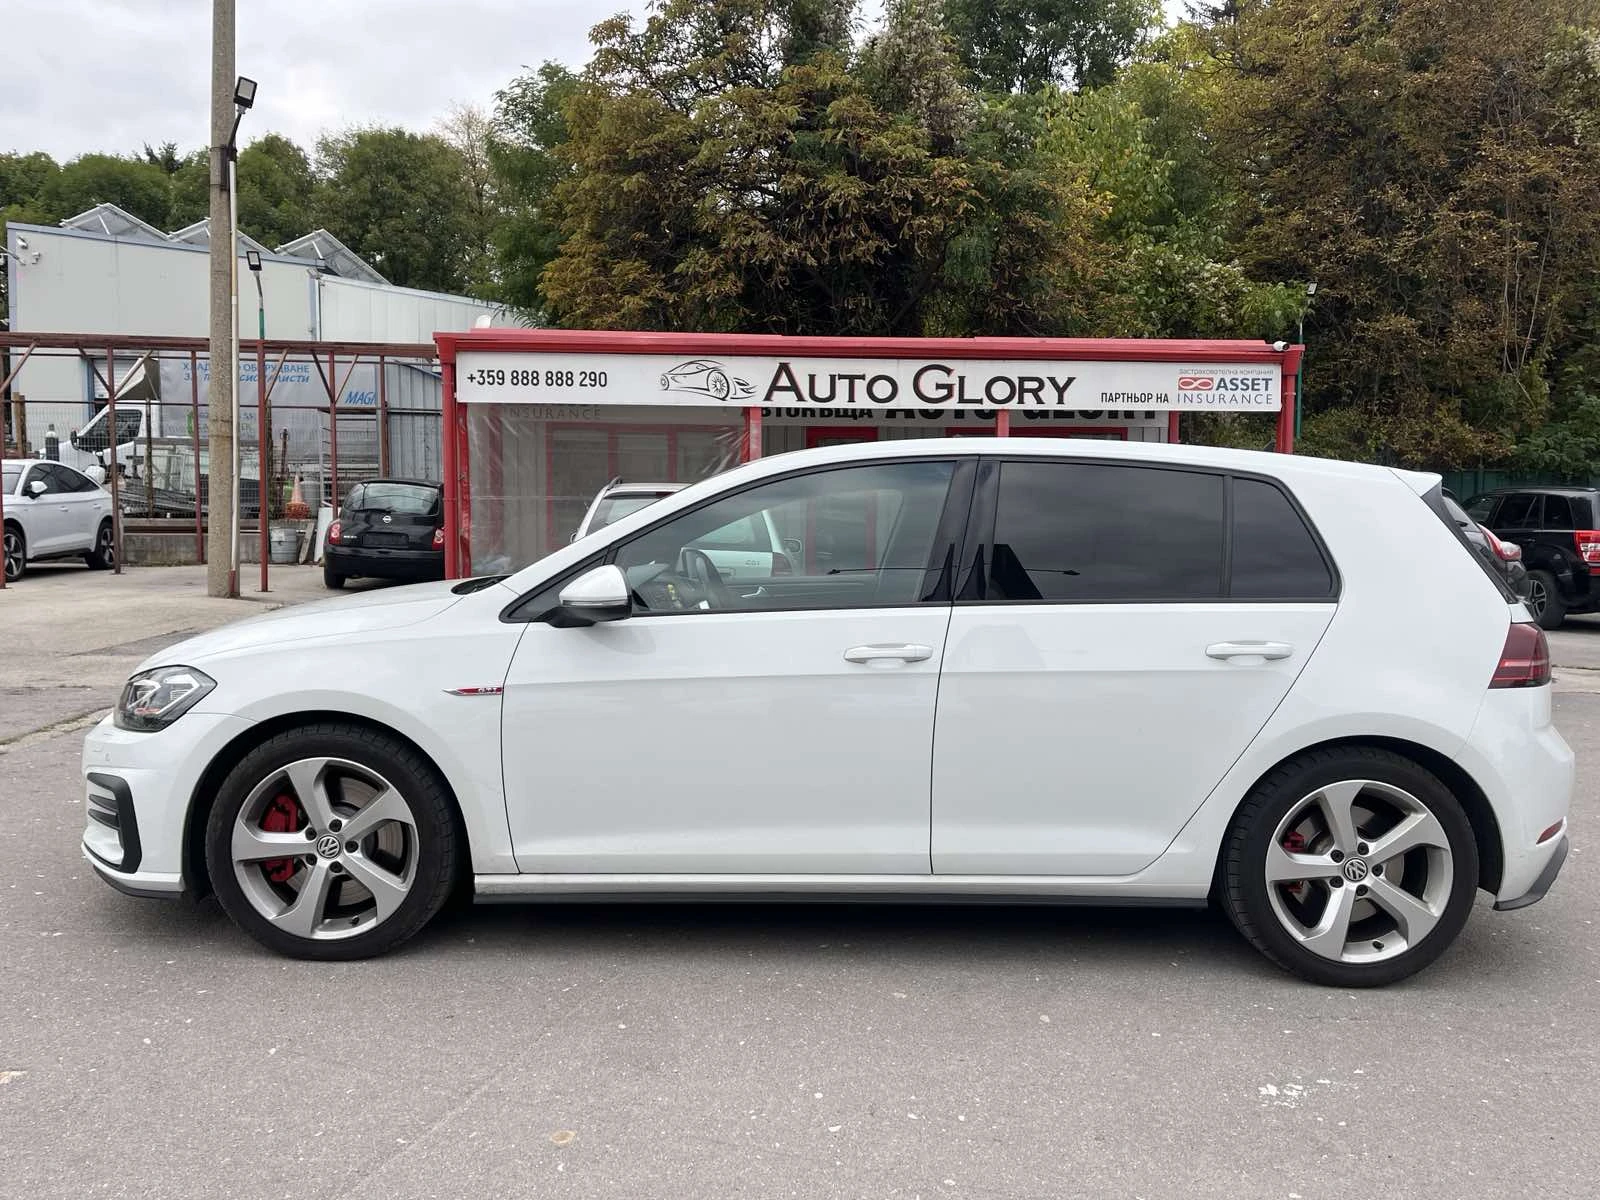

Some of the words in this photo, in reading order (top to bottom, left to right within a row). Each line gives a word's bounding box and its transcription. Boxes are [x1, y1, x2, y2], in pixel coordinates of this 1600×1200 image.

[467, 370, 505, 386] +359
[511, 370, 540, 386] 888
[545, 371, 574, 387] 888
[579, 371, 608, 387] 290
[763, 362, 898, 403] AUTO
[912, 364, 1076, 405] GLORY
[1216, 378, 1272, 391] ASSET
[1101, 392, 1153, 404] ПАРТНЬОР
[1156, 393, 1169, 404] НА
[1177, 393, 1273, 405] INSURANCE
